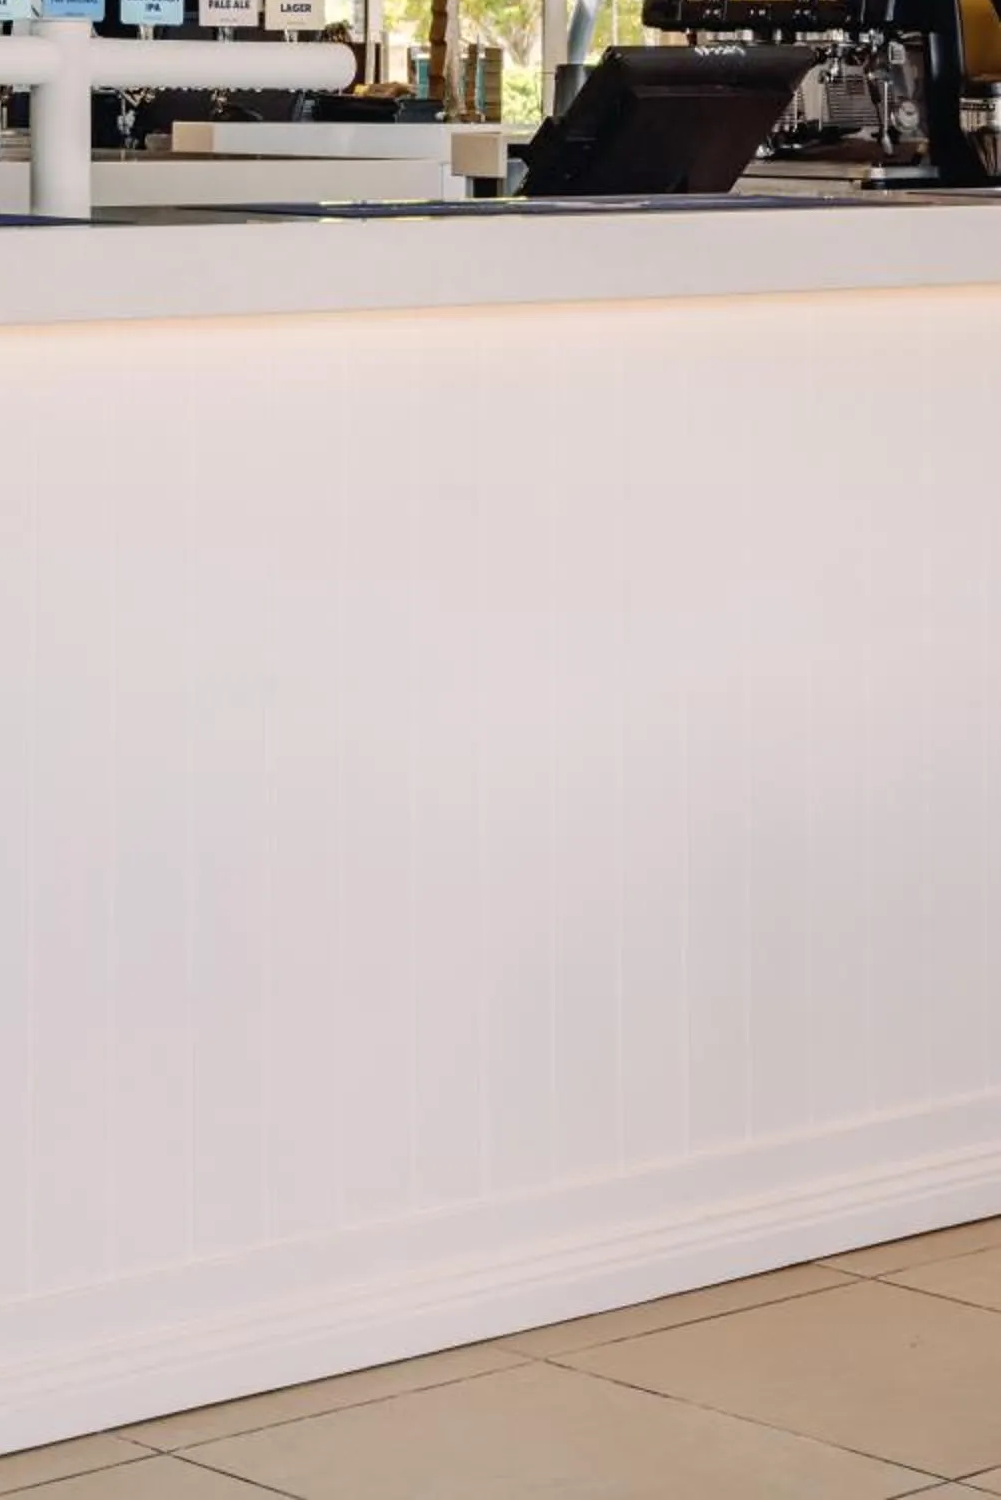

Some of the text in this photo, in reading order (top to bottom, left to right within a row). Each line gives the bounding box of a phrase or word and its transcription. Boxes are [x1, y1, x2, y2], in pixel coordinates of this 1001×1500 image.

[145, 2, 161, 12] IPA
[208, 0, 250, 9] PALE ALE
[280, 3, 312, 13] LAGER
